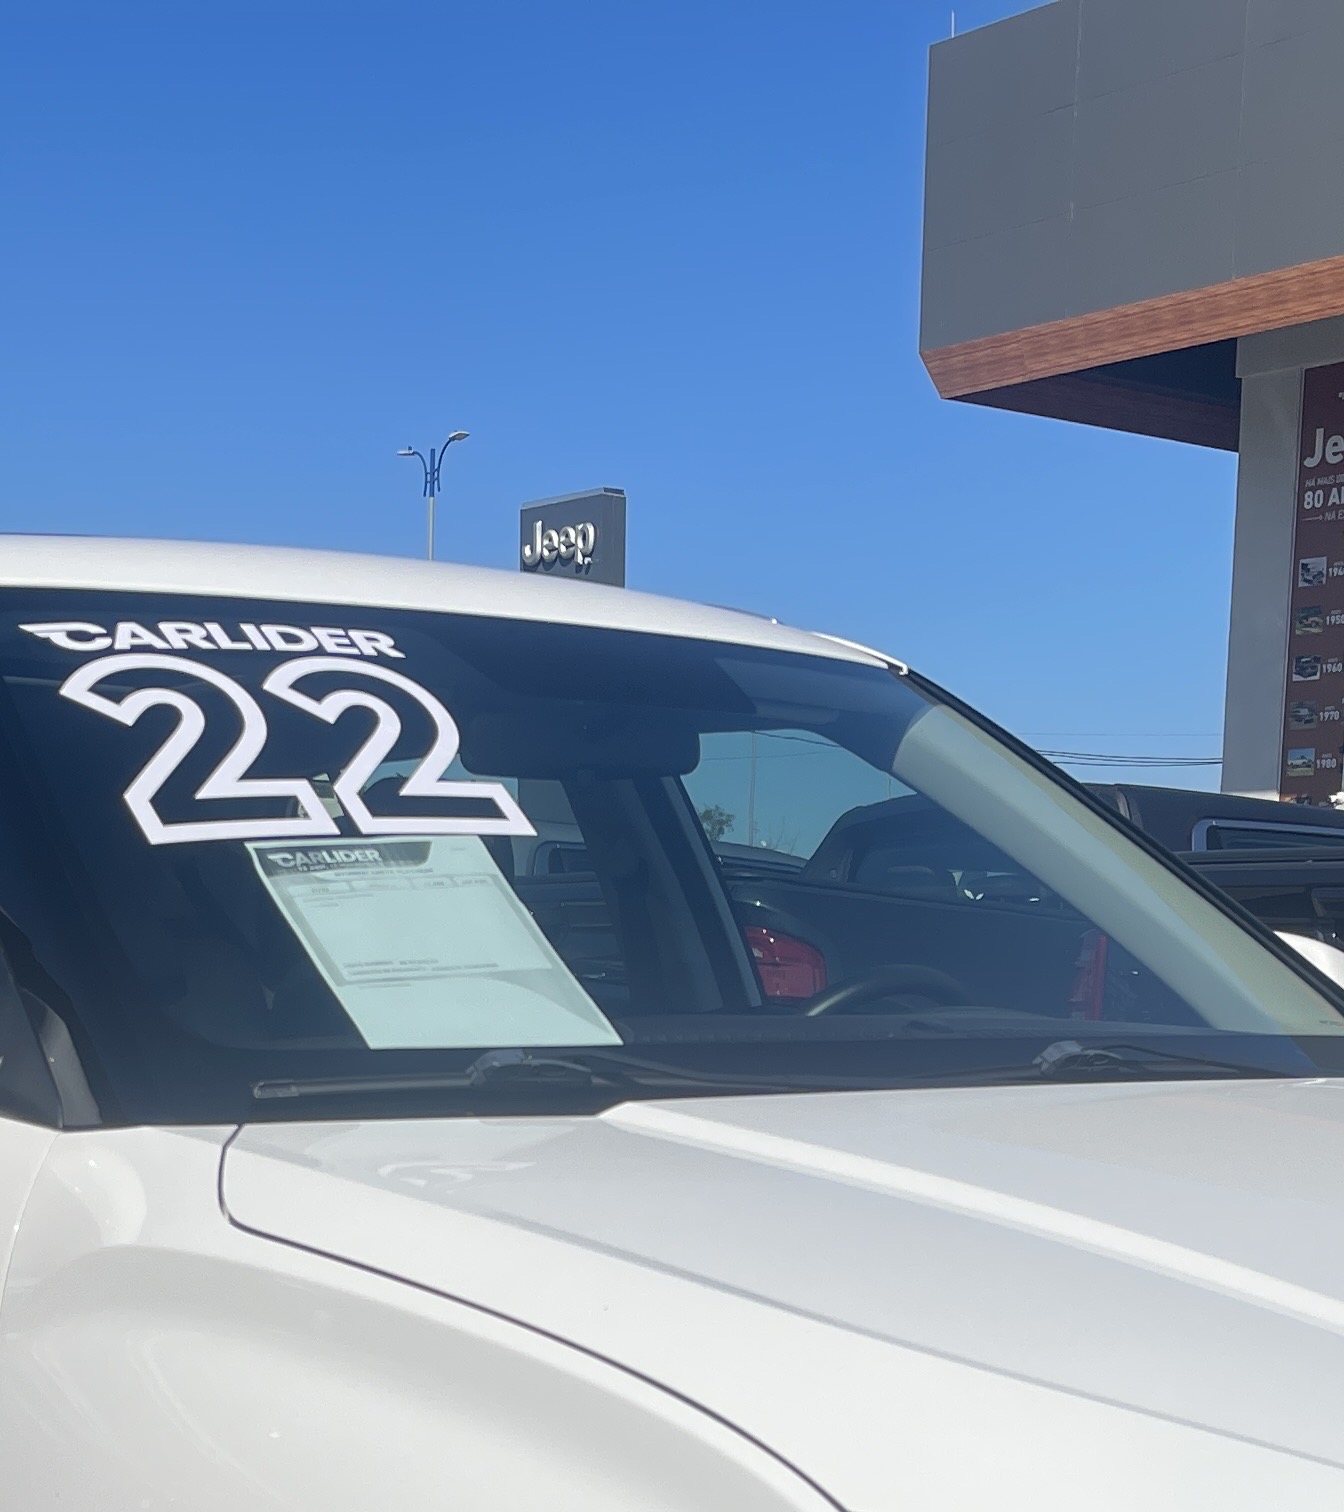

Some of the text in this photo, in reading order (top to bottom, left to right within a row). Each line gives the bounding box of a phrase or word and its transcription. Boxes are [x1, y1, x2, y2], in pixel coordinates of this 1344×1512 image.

[1304, 489, 1324, 510] 80
[522, 520, 594, 566] Jeep
[19, 621, 406, 658] CARLIDER
[1322, 663, 1343, 674] 1960
[1319, 711, 1340, 721] 1970
[59, 653, 538, 845] 22
[1316, 758, 1337, 769] 1980
[267, 848, 383, 868] CARLIDER
